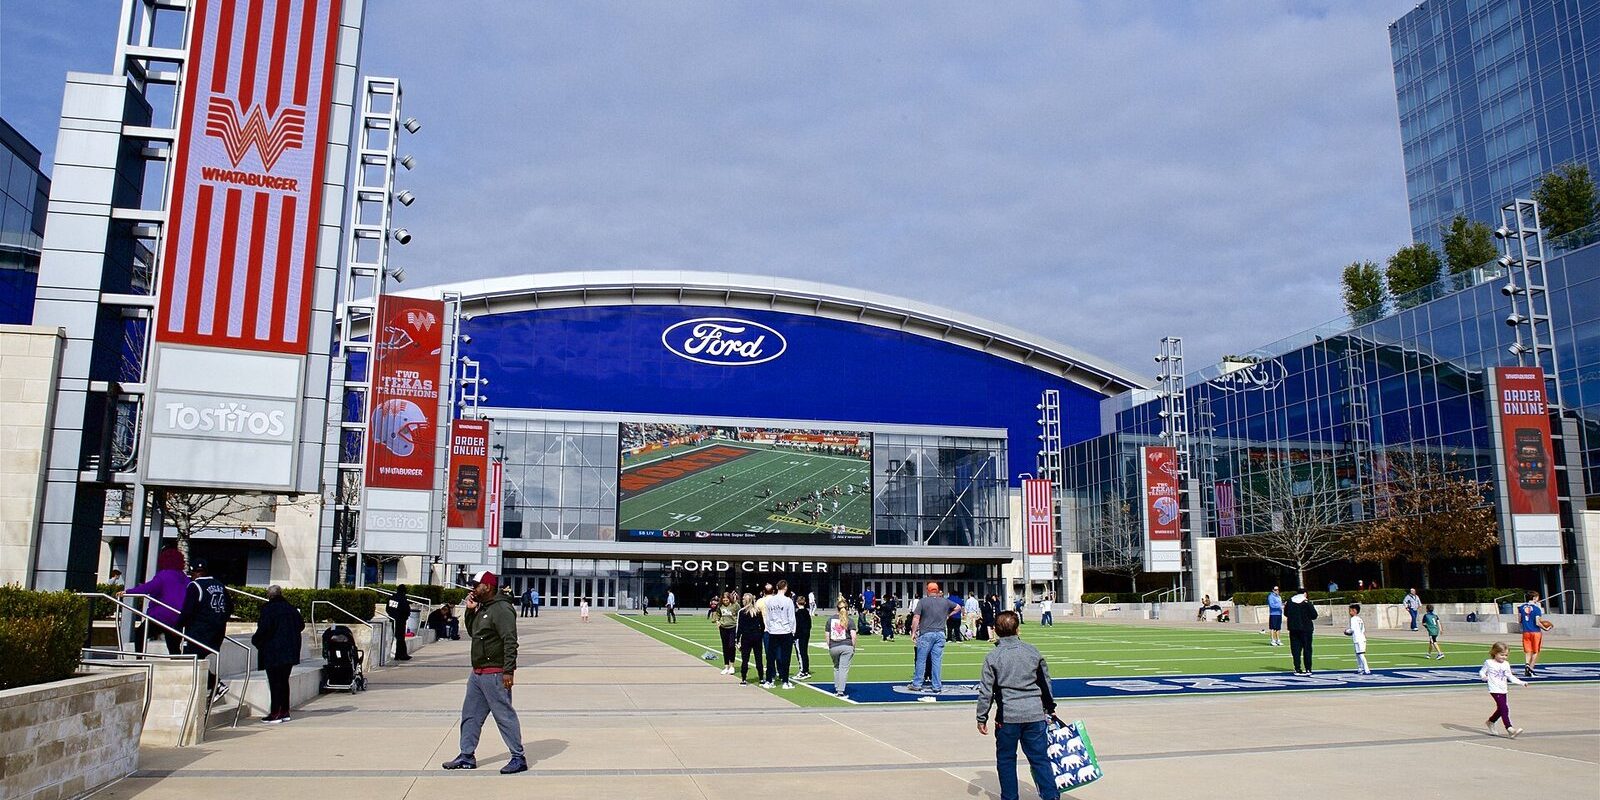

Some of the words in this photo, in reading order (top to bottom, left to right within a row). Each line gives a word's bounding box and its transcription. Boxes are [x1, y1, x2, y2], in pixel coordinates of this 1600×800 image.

[202, 167, 298, 192] WHATABURGER
[684, 323, 765, 358] Ford
[396, 370, 419, 379] TWO
[382, 376, 433, 390] TEXAS
[376, 386, 437, 399] TRADITIONS
[1503, 389, 1541, 402] ORDER
[1503, 402, 1545, 415] ONLINE
[455, 436, 485, 447] ORDER
[453, 445, 486, 456] ONLINE
[671, 560, 729, 572] FORD
[742, 561, 828, 573] CENTER
[210, 593, 225, 613] 44
